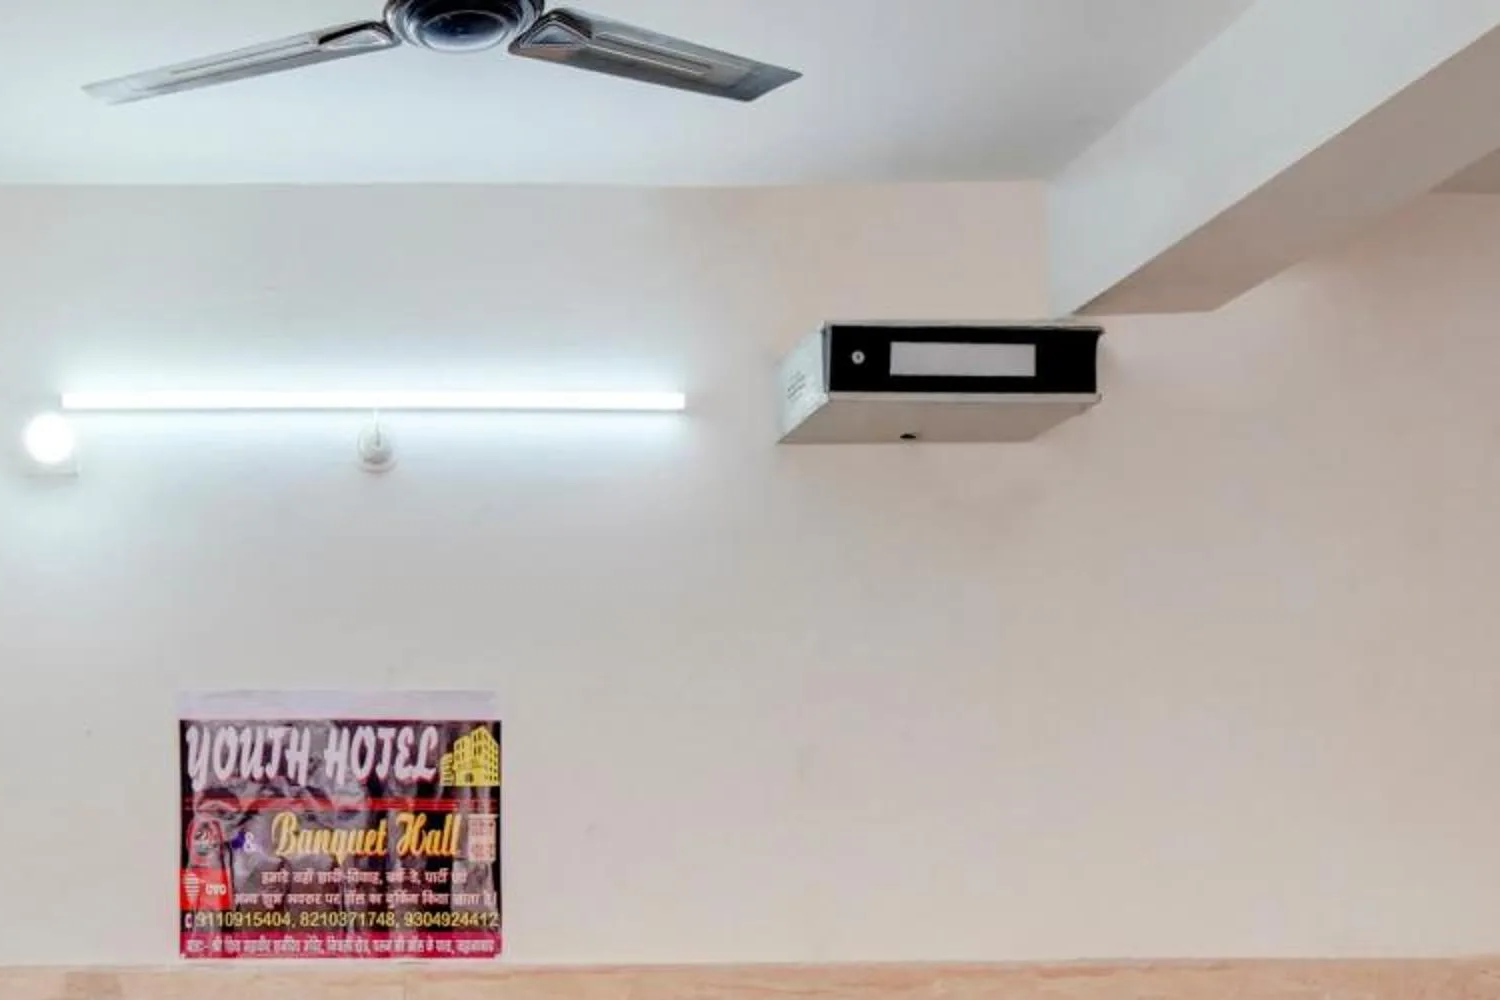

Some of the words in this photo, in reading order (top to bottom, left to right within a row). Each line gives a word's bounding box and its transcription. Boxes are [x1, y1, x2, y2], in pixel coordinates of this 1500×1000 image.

[186, 725, 309, 792] YOUTH
[323, 725, 440, 784] HOTEL
[271, 812, 388, 866] Banquet
[395, 813, 462, 857] Hall
